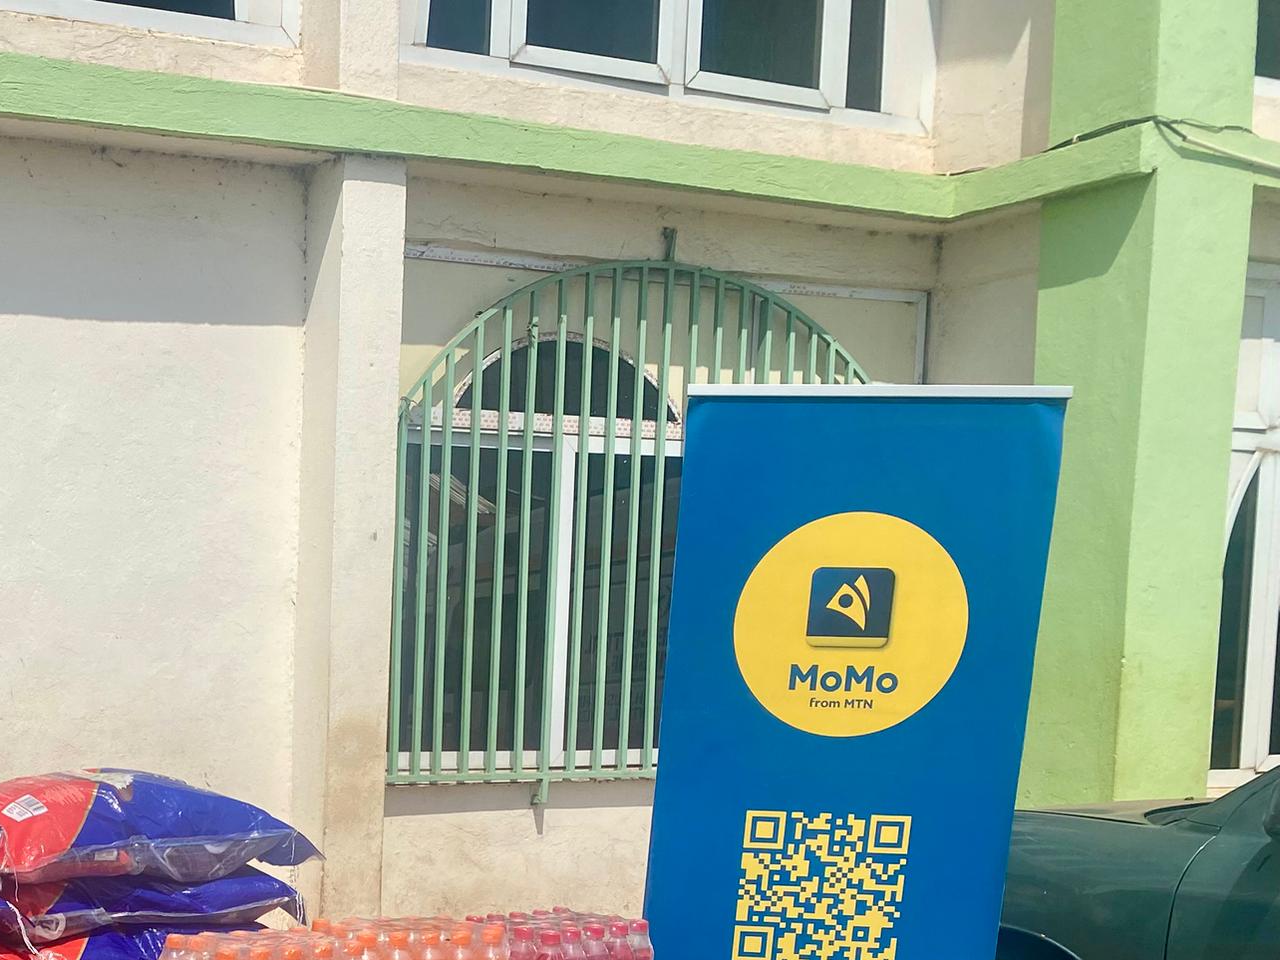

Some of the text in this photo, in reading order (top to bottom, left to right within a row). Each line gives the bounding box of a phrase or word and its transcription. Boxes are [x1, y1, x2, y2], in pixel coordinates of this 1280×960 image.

[788, 664, 899, 694] MoMo
[809, 697, 873, 709] from MTN
